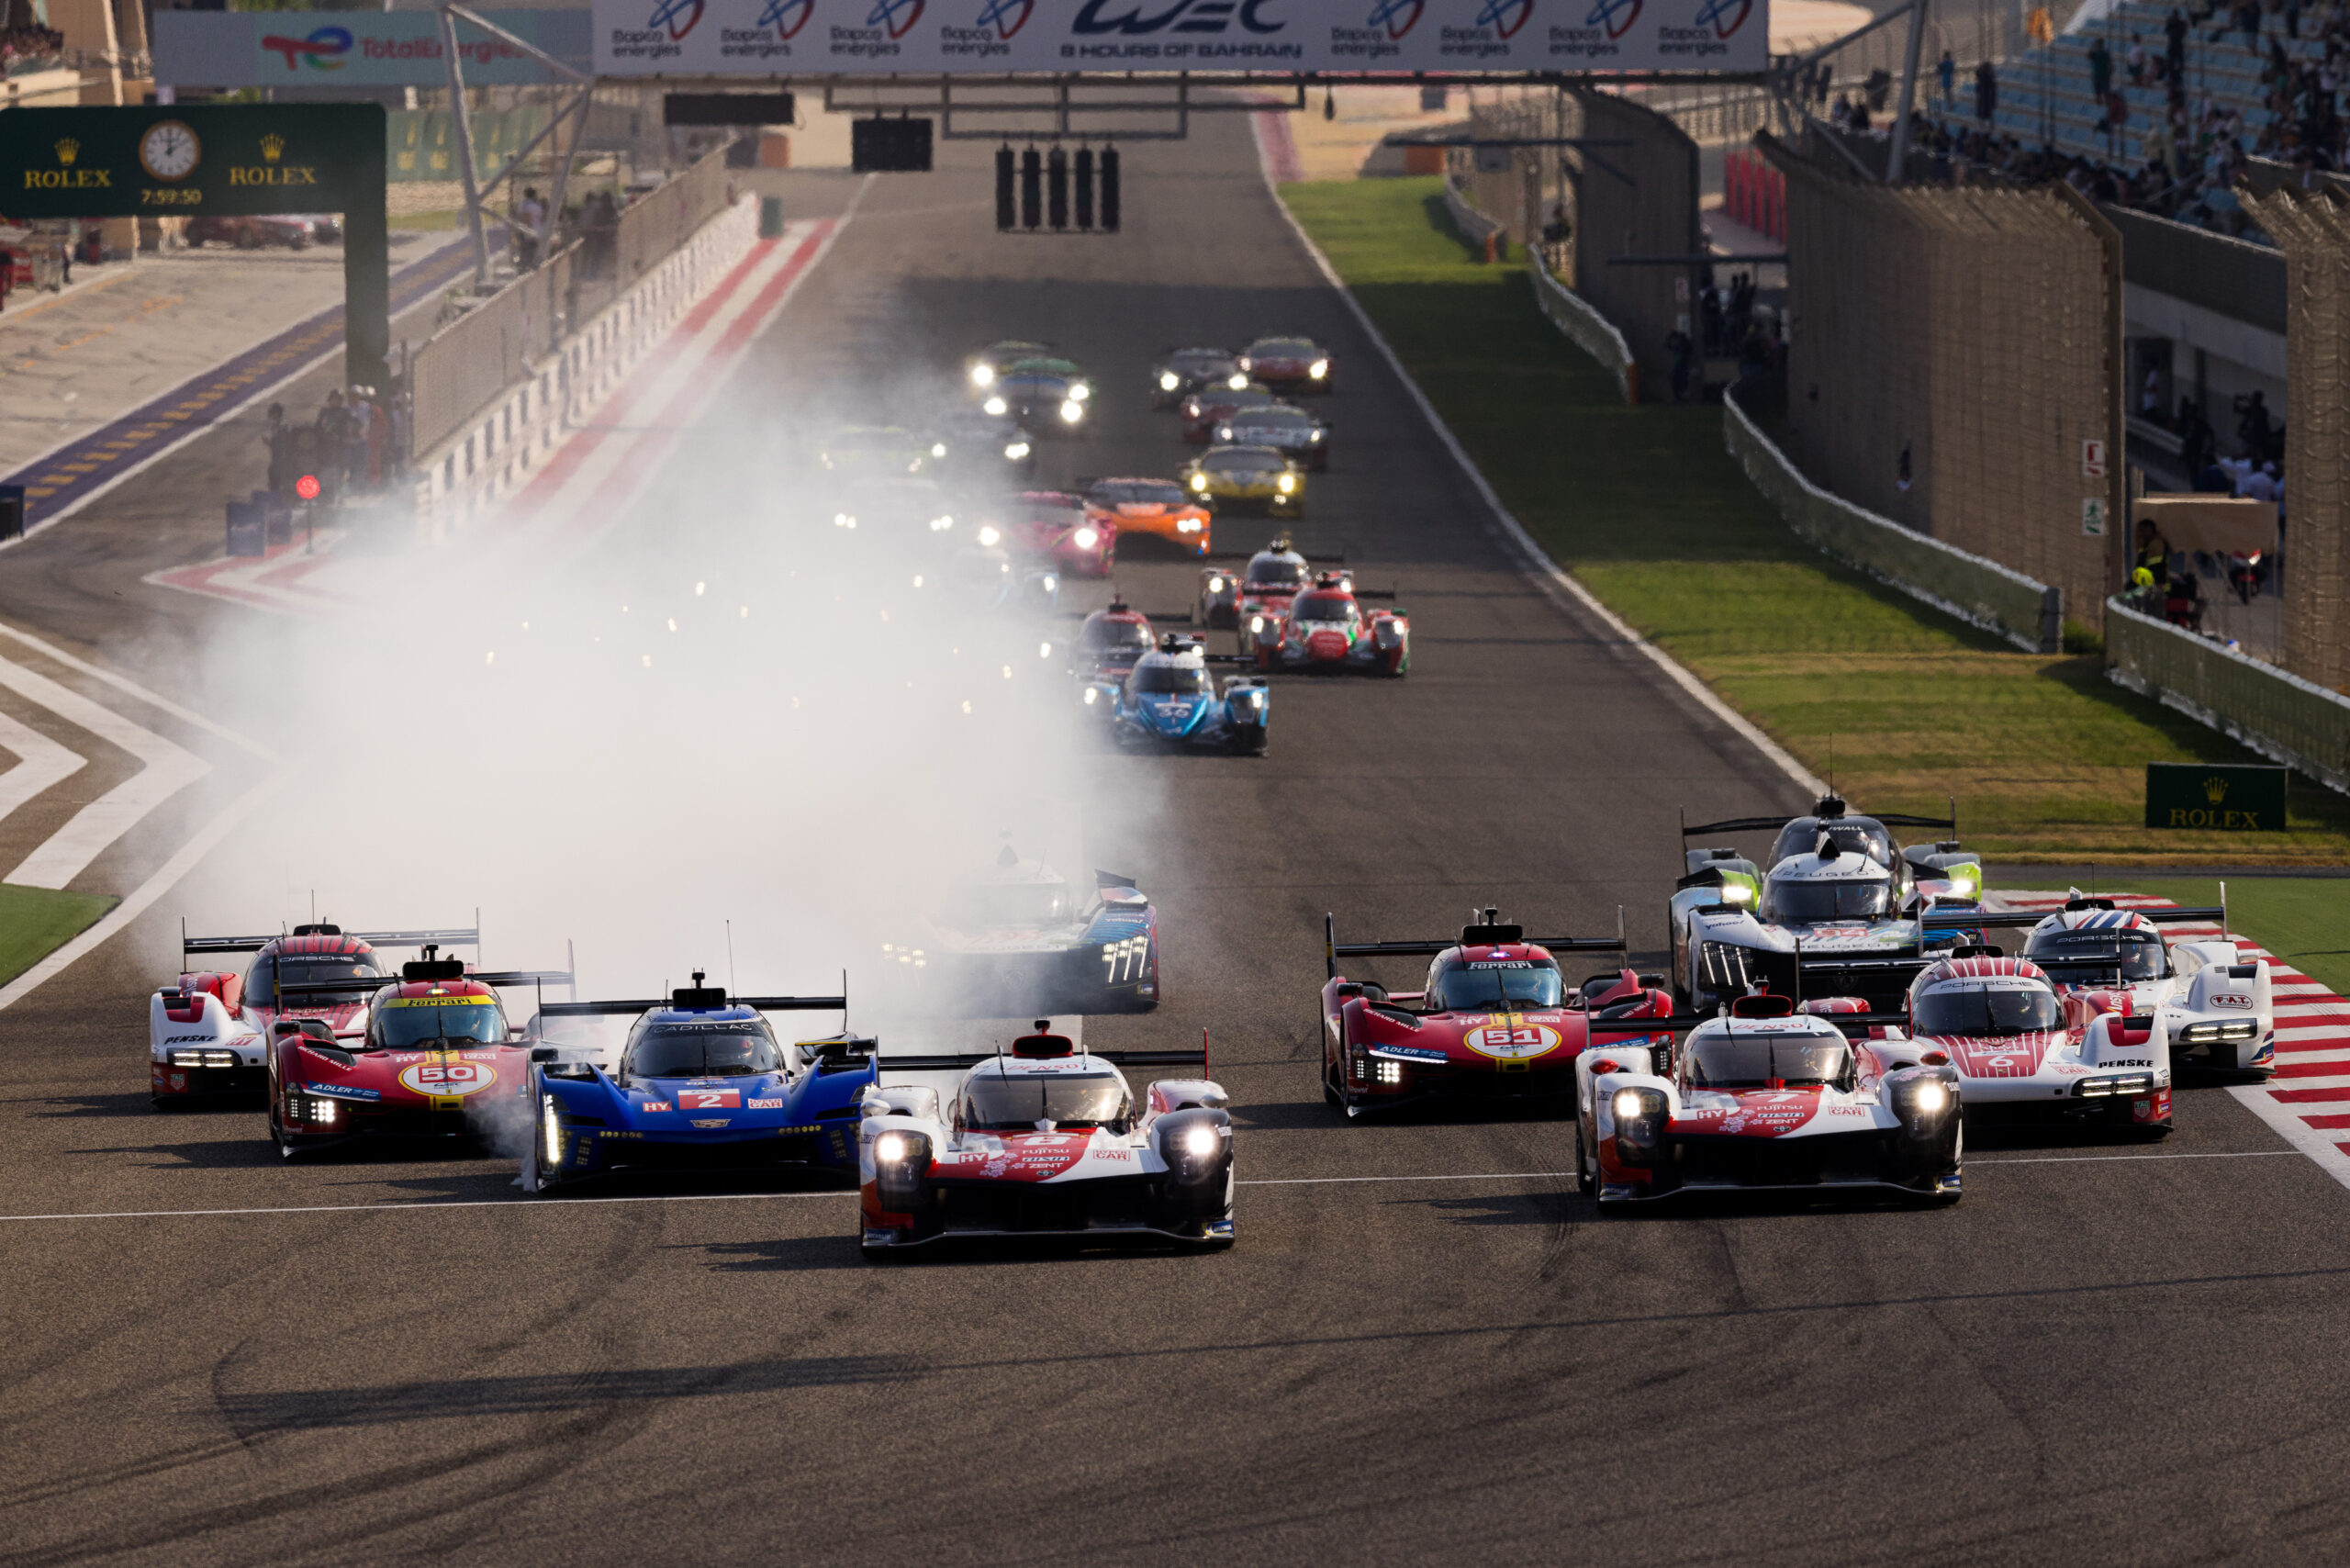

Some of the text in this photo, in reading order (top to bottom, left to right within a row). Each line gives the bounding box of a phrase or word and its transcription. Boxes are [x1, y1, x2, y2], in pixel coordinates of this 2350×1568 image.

[359, 37, 526, 64] TotalErgie
[612, 44, 682, 60] energies
[721, 43, 791, 59] energies
[830, 42, 901, 58] energies
[941, 41, 1010, 57] energies
[1080, 43, 1160, 58] HOURS
[1164, 43, 1192, 58] OF
[1198, 43, 1303, 59] BAHRAIN
[1331, 41, 1401, 57] energies
[1440, 42, 1510, 58] energies
[1550, 42, 1619, 58] energies
[1659, 41, 1729, 57] energies
[24, 170, 113, 189] ROLEX
[230, 167, 317, 185] ROLEX
[141, 189, 203, 205] 7:59:50
[2169, 808, 2259, 829] ROLEX
[2056, 935, 2145, 944] PORSCHE
[1468, 960, 1534, 970] Ferrari
[1940, 980, 2034, 990] PORSCHE
[408, 997, 473, 1007] Ferrari
[1363, 1008, 1421, 1033] RICHARD MILLE
[1460, 1016, 1484, 1025] HY
[654, 1024, 753, 1034] CADILLAC
[164, 1034, 218, 1045] PENSKE
[1486, 1029, 1539, 1044] 51
[1379, 1046, 1419, 1055] ADLER
[297, 1046, 352, 1072] RICHARD MILLE
[396, 1055, 420, 1063] HY
[1988, 1055, 2014, 1067] 6
[2098, 1058, 2154, 1069] PENSKE
[421, 1067, 475, 1081] 50
[1007, 1063, 1079, 1071] DENSO
[312, 1084, 353, 1094] ADLER
[644, 1103, 670, 1111] HY
[698, 1094, 723, 1108] 2
[1698, 1110, 1723, 1119] HY
[1830, 1109, 1864, 1117] CAR
[961, 1153, 988, 1162] HY
